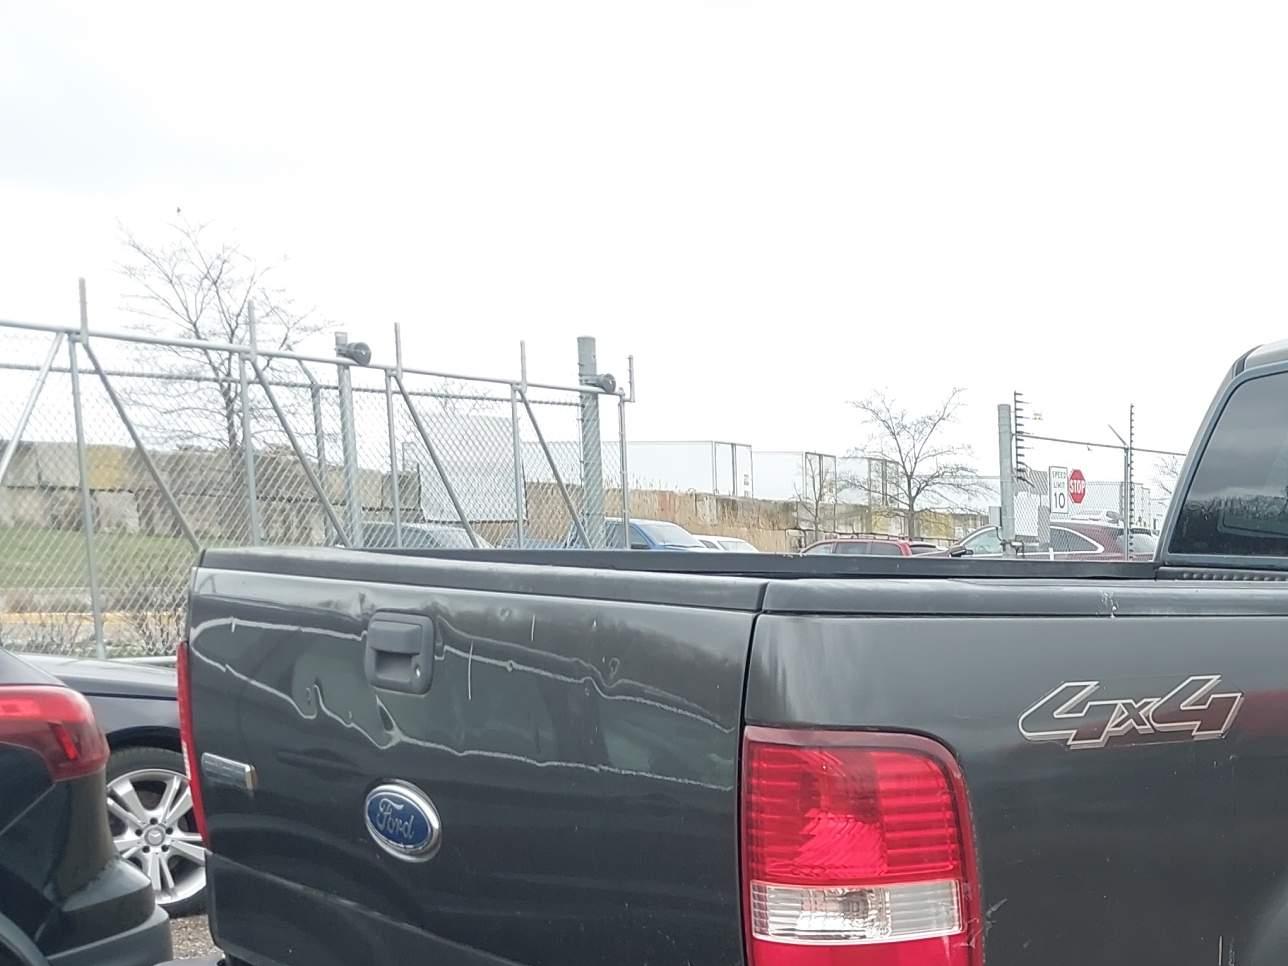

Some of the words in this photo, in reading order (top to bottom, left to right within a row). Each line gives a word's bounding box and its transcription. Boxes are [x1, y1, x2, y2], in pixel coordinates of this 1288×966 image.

[1052, 470, 1066, 479] SPEED
[1070, 480, 1085, 494] STOP
[1054, 492, 1066, 509] 10
[376, 798, 415, 839] Ford
